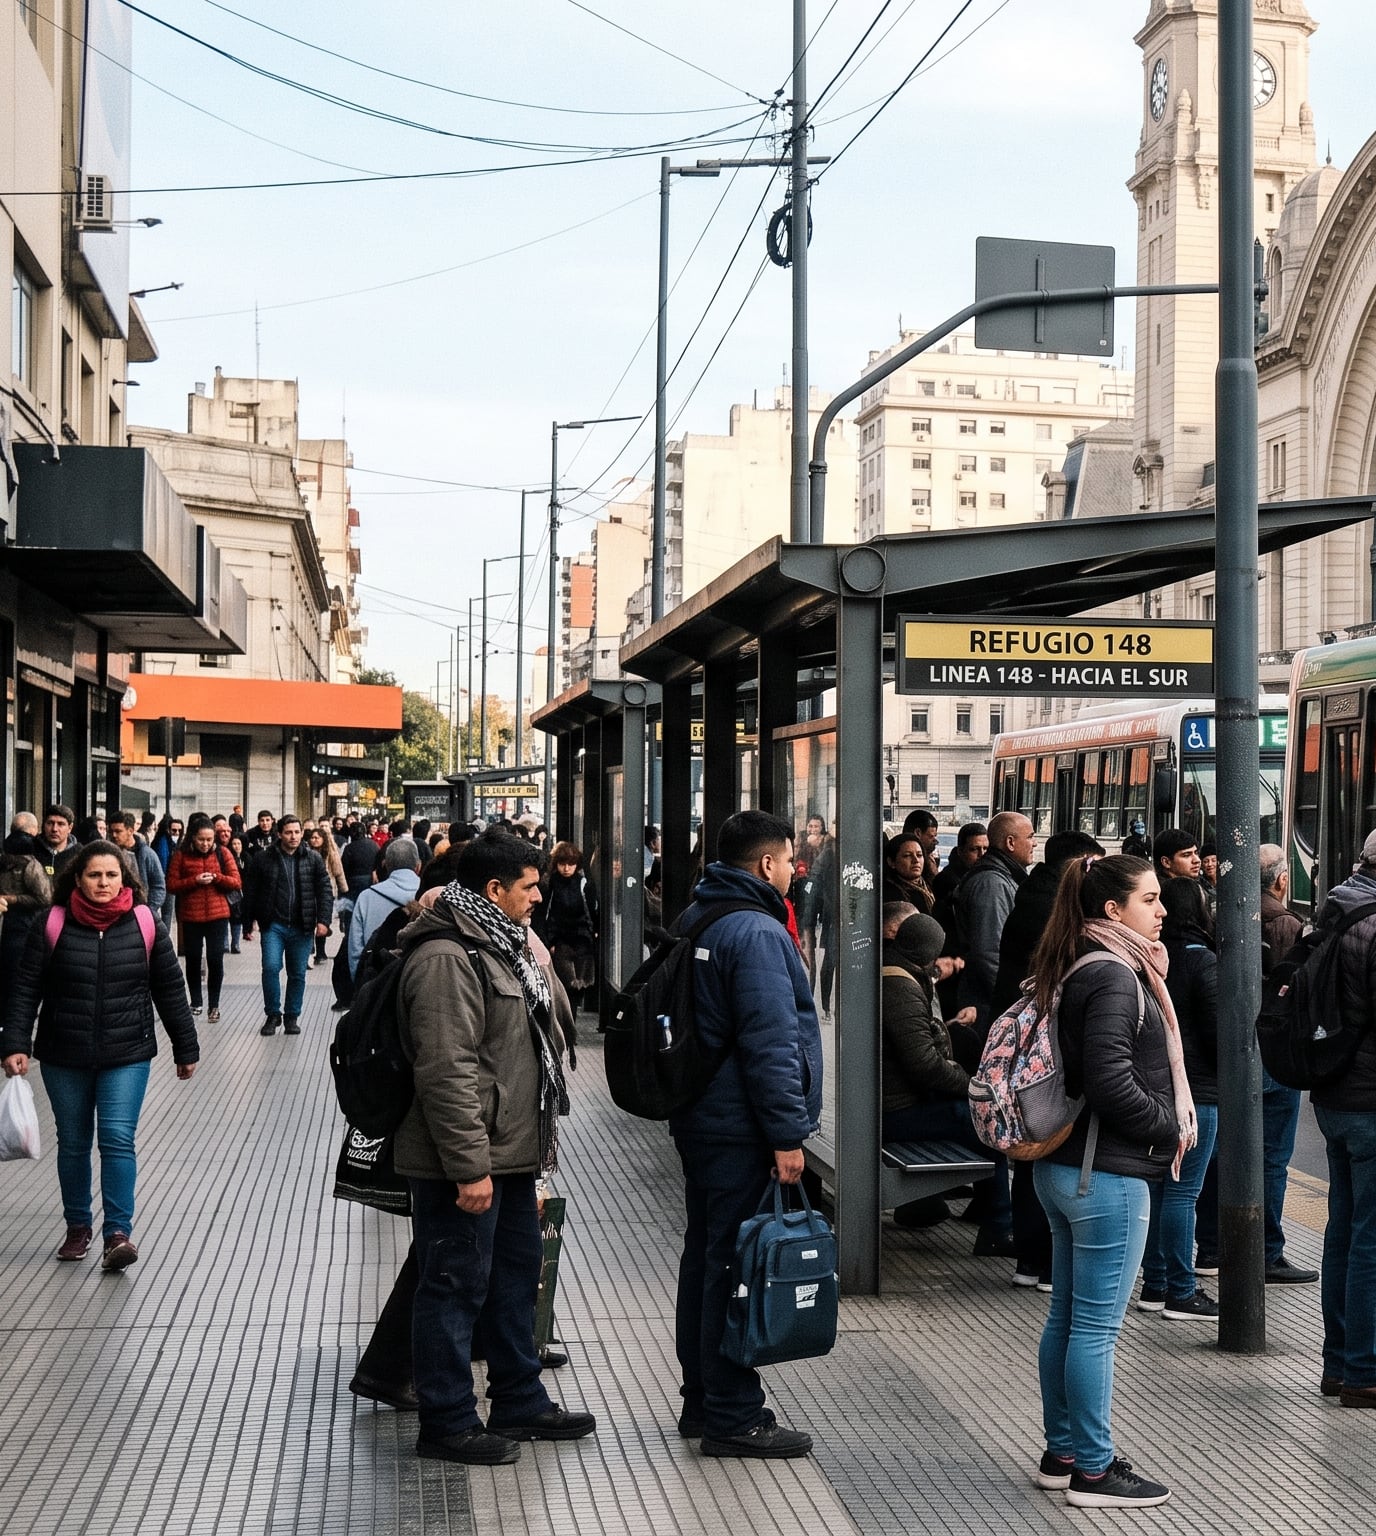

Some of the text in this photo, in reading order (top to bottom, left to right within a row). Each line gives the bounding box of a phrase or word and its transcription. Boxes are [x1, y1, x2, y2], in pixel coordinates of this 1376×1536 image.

[969, 630, 1152, 656] REFUGIO 148
[929, 665, 990, 684] LINEA
[996, 667, 1033, 685] 148
[1051, 667, 1115, 686] HACIA
[1121, 668, 1144, 686] EL
[1148, 669, 1188, 686] SUR
